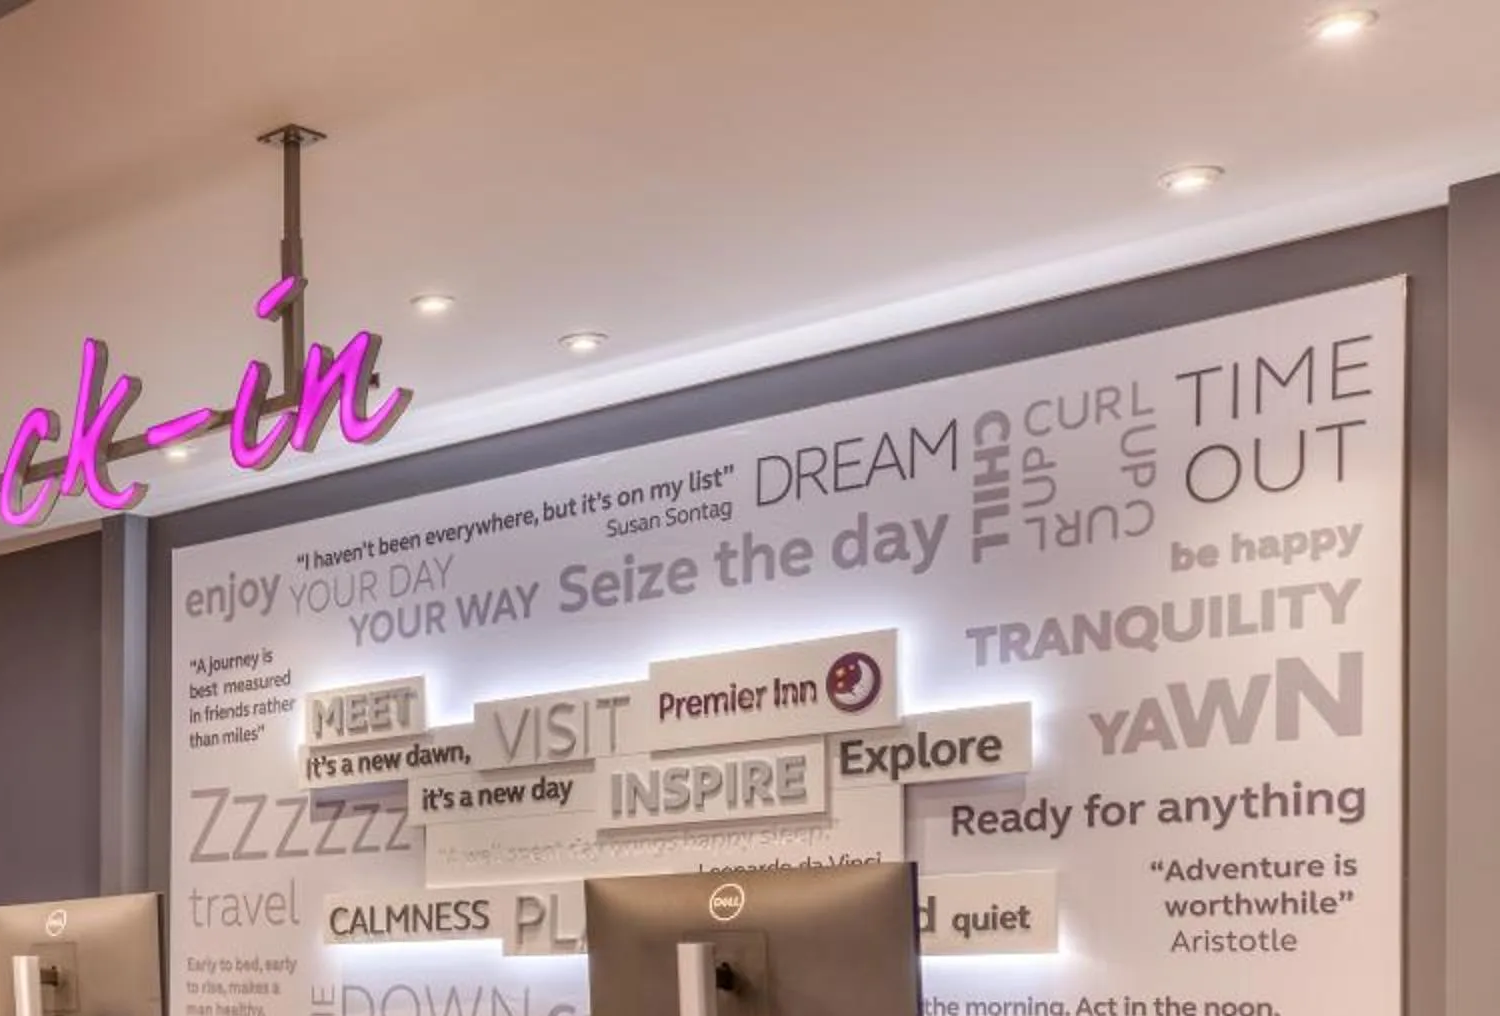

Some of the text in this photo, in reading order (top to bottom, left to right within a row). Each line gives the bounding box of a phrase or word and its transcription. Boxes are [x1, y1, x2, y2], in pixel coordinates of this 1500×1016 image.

[1175, 335, 1373, 427] TIME
[1024, 381, 1155, 437] CURL
[757, 418, 957, 507] DREAM
[1022, 446, 1057, 508] UP
[1120, 424, 1156, 488] UP
[1185, 420, 1366, 503] OUT
[973, 410, 1011, 563] CHILL
[313, 542, 375, 569] haven't
[378, 534, 420, 556] been
[426, 508, 539, 546] everywhere,
[543, 499, 576, 522] but
[582, 490, 612, 514] it's
[617, 486, 644, 507] on
[650, 478, 683, 505] my
[606, 498, 733, 538] Susan Sontag
[1024, 500, 1155, 551] CURL
[559, 512, 949, 614] Seize the day
[1171, 523, 1364, 572] be happy
[185, 571, 281, 623] enjoy
[290, 554, 455, 615] YOUR DAY
[349, 582, 539, 648] YOUR WAY
[966, 578, 1363, 667] TRANQUILITY
[190, 668, 291, 699] best measured
[208, 652, 260, 676] journey
[262, 647, 273, 663] is
[190, 696, 297, 724] in friends rather
[311, 687, 419, 739] MEET
[659, 677, 817, 722] Premier Inn
[1089, 651, 1364, 755] YAWN
[190, 731, 219, 749] than
[494, 696, 631, 762] VISIT
[341, 757, 353, 774] a
[358, 748, 401, 772] new
[406, 743, 471, 769] dawn,
[839, 732, 1003, 780] Explore
[459, 791, 474, 808] a
[477, 785, 525, 807] new
[532, 776, 573, 806] day
[611, 755, 808, 818] INSPIRE
[952, 781, 1367, 839] Ready for anything
[1334, 854, 1357, 877] is
[189, 877, 299, 928] travel
[329, 899, 490, 936] CALMNESS
[952, 904, 1031, 937] quiet
[186, 955, 298, 975] Early to bed, early
[1171, 928, 1297, 953] Aristotle
[186, 981, 199, 994] to
[229, 980, 269, 995] makes
[272, 984, 280, 995] a
[186, 1004, 213, 1016] man
[925, 997, 959, 1016] the
[1075, 996, 1117, 1016] Act
[1123, 995, 1147, 1016] in
[1153, 995, 1197, 1016] the
